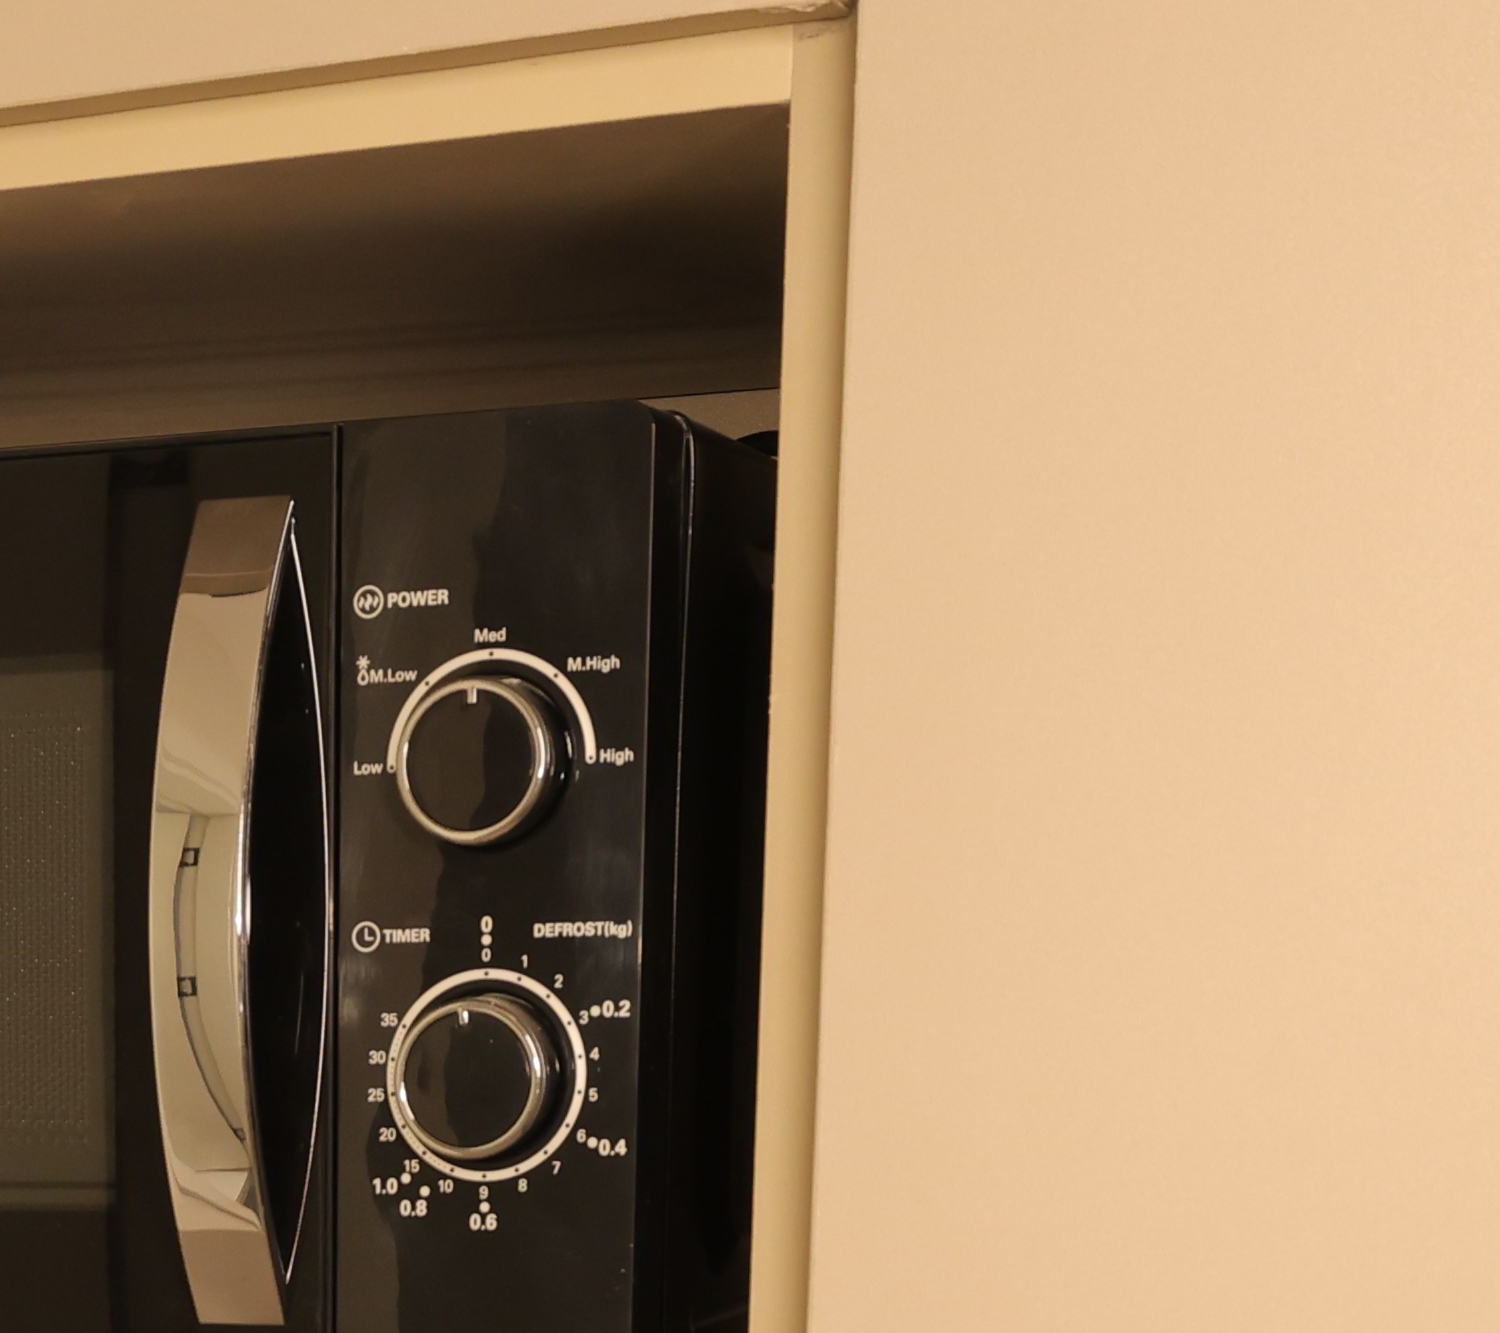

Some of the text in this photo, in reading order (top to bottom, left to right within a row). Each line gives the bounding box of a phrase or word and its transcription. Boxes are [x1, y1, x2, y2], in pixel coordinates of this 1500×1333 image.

[387, 588, 449, 608] POWER
[473, 627, 507, 644] Med
[566, 654, 621, 673] M.High
[369, 668, 418, 684] M.Low
[599, 748, 635, 765] High
[353, 760, 384, 776] Low
[480, 915, 493, 934] 0
[532, 920, 633, 939] DEFROST(kg)
[382, 927, 431, 944] TIMER
[481, 947, 492, 963] 0
[521, 954, 529, 969] 1
[553, 974, 564, 988] 2
[601, 1000, 631, 1018] 0.2
[380, 1013, 399, 1028] 35
[579, 1010, 590, 1025] 3
[368, 1050, 386, 1066] 30
[589, 1046, 600, 1061] 4
[367, 1088, 385, 1103] 25
[588, 1088, 599, 1102] 5
[379, 1127, 397, 1142] 20
[576, 1129, 587, 1144] 6
[598, 1139, 628, 1157] 0.4
[405, 1159, 421, 1174] 15
[552, 1161, 563, 1175] 7
[372, 1178, 398, 1196] 1.0
[438, 1179, 454, 1194] 10
[479, 1186, 490, 1201] 9
[518, 1178, 528, 1193] 8
[400, 1200, 428, 1217] 0.8
[469, 1213, 498, 1232] 0.6
